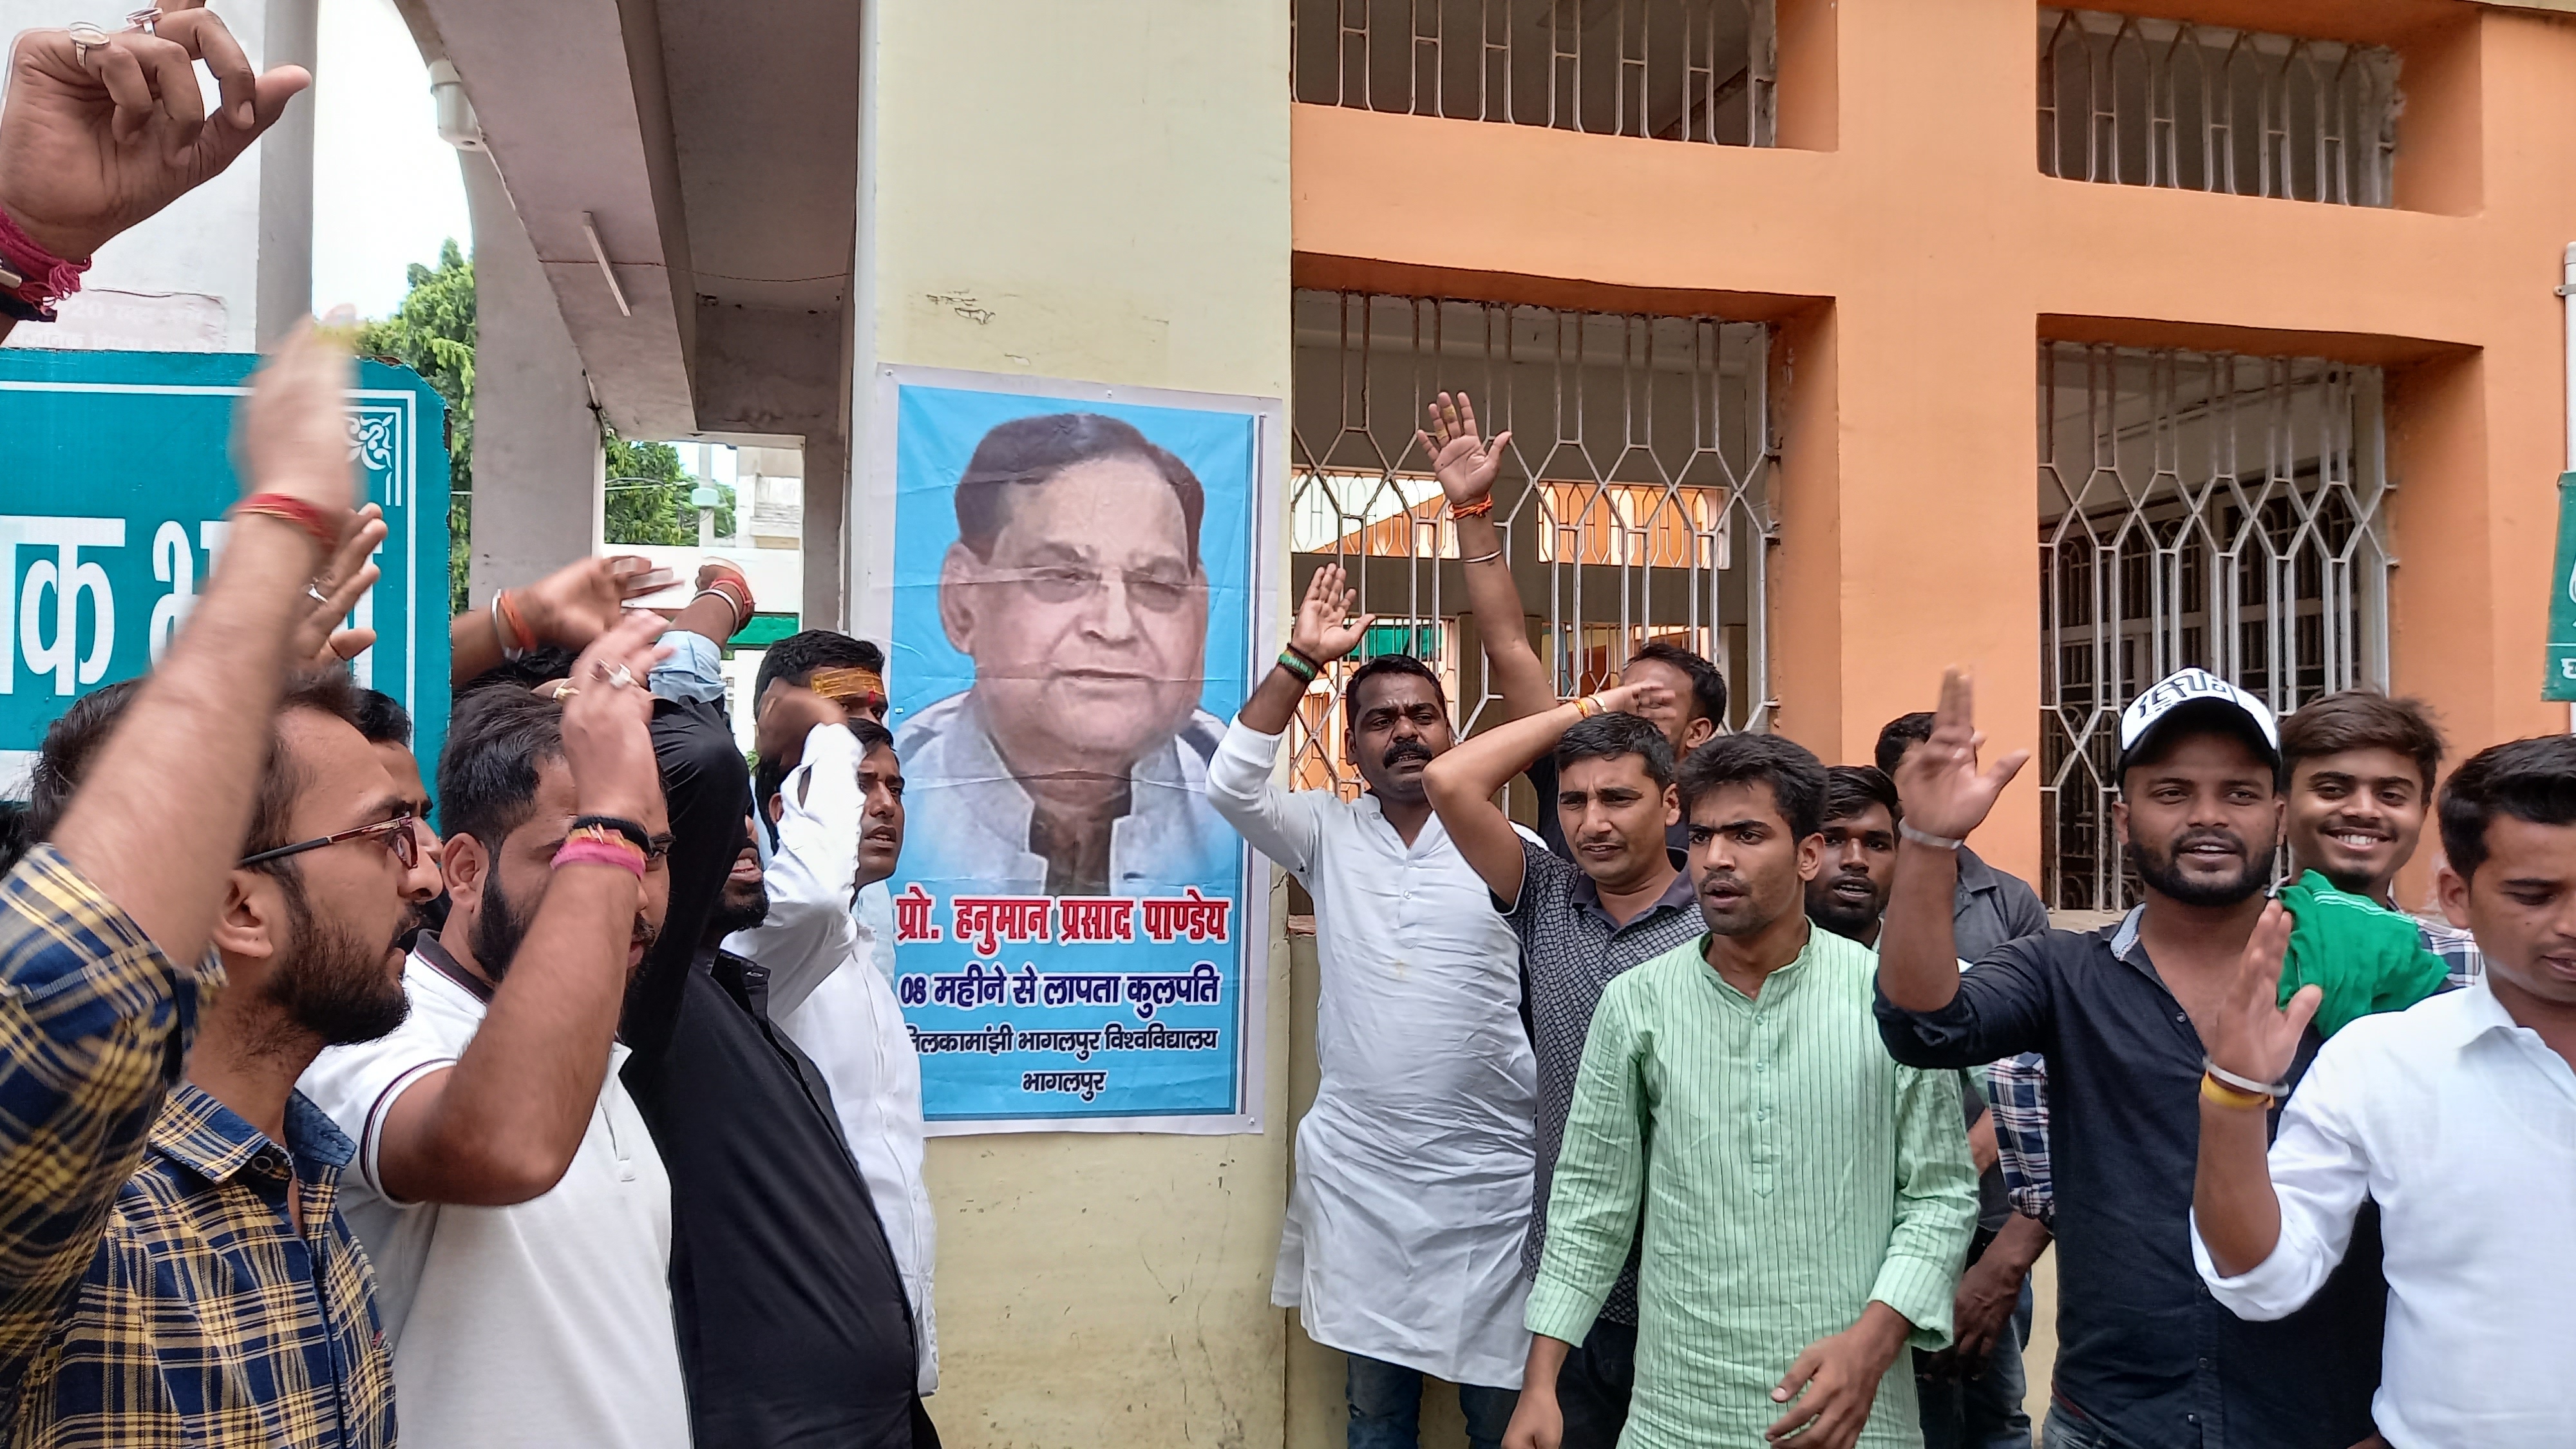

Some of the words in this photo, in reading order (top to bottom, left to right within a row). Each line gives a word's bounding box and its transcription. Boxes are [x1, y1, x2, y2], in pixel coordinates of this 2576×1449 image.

[0, 515, 125, 696] क
[896, 886, 939, 941] प्रो.
[954, 899, 1051, 954] हनुमान
[1059, 900, 1133, 940] प्रसाद
[1142, 889, 1229, 940] पाण्डेय
[902, 977, 926, 1004] 08
[934, 964, 1007, 1007] महीने
[1012, 965, 1036, 1004] से
[1043, 976, 1121, 1005] लापता
[1127, 964, 1220, 1018] कुलपति
[1018, 1030, 1101, 1060] भागलपुर
[1104, 1023, 1218, 1050] विश्वविद्यालय
[1022, 1072, 1106, 1101] भागलपुर
